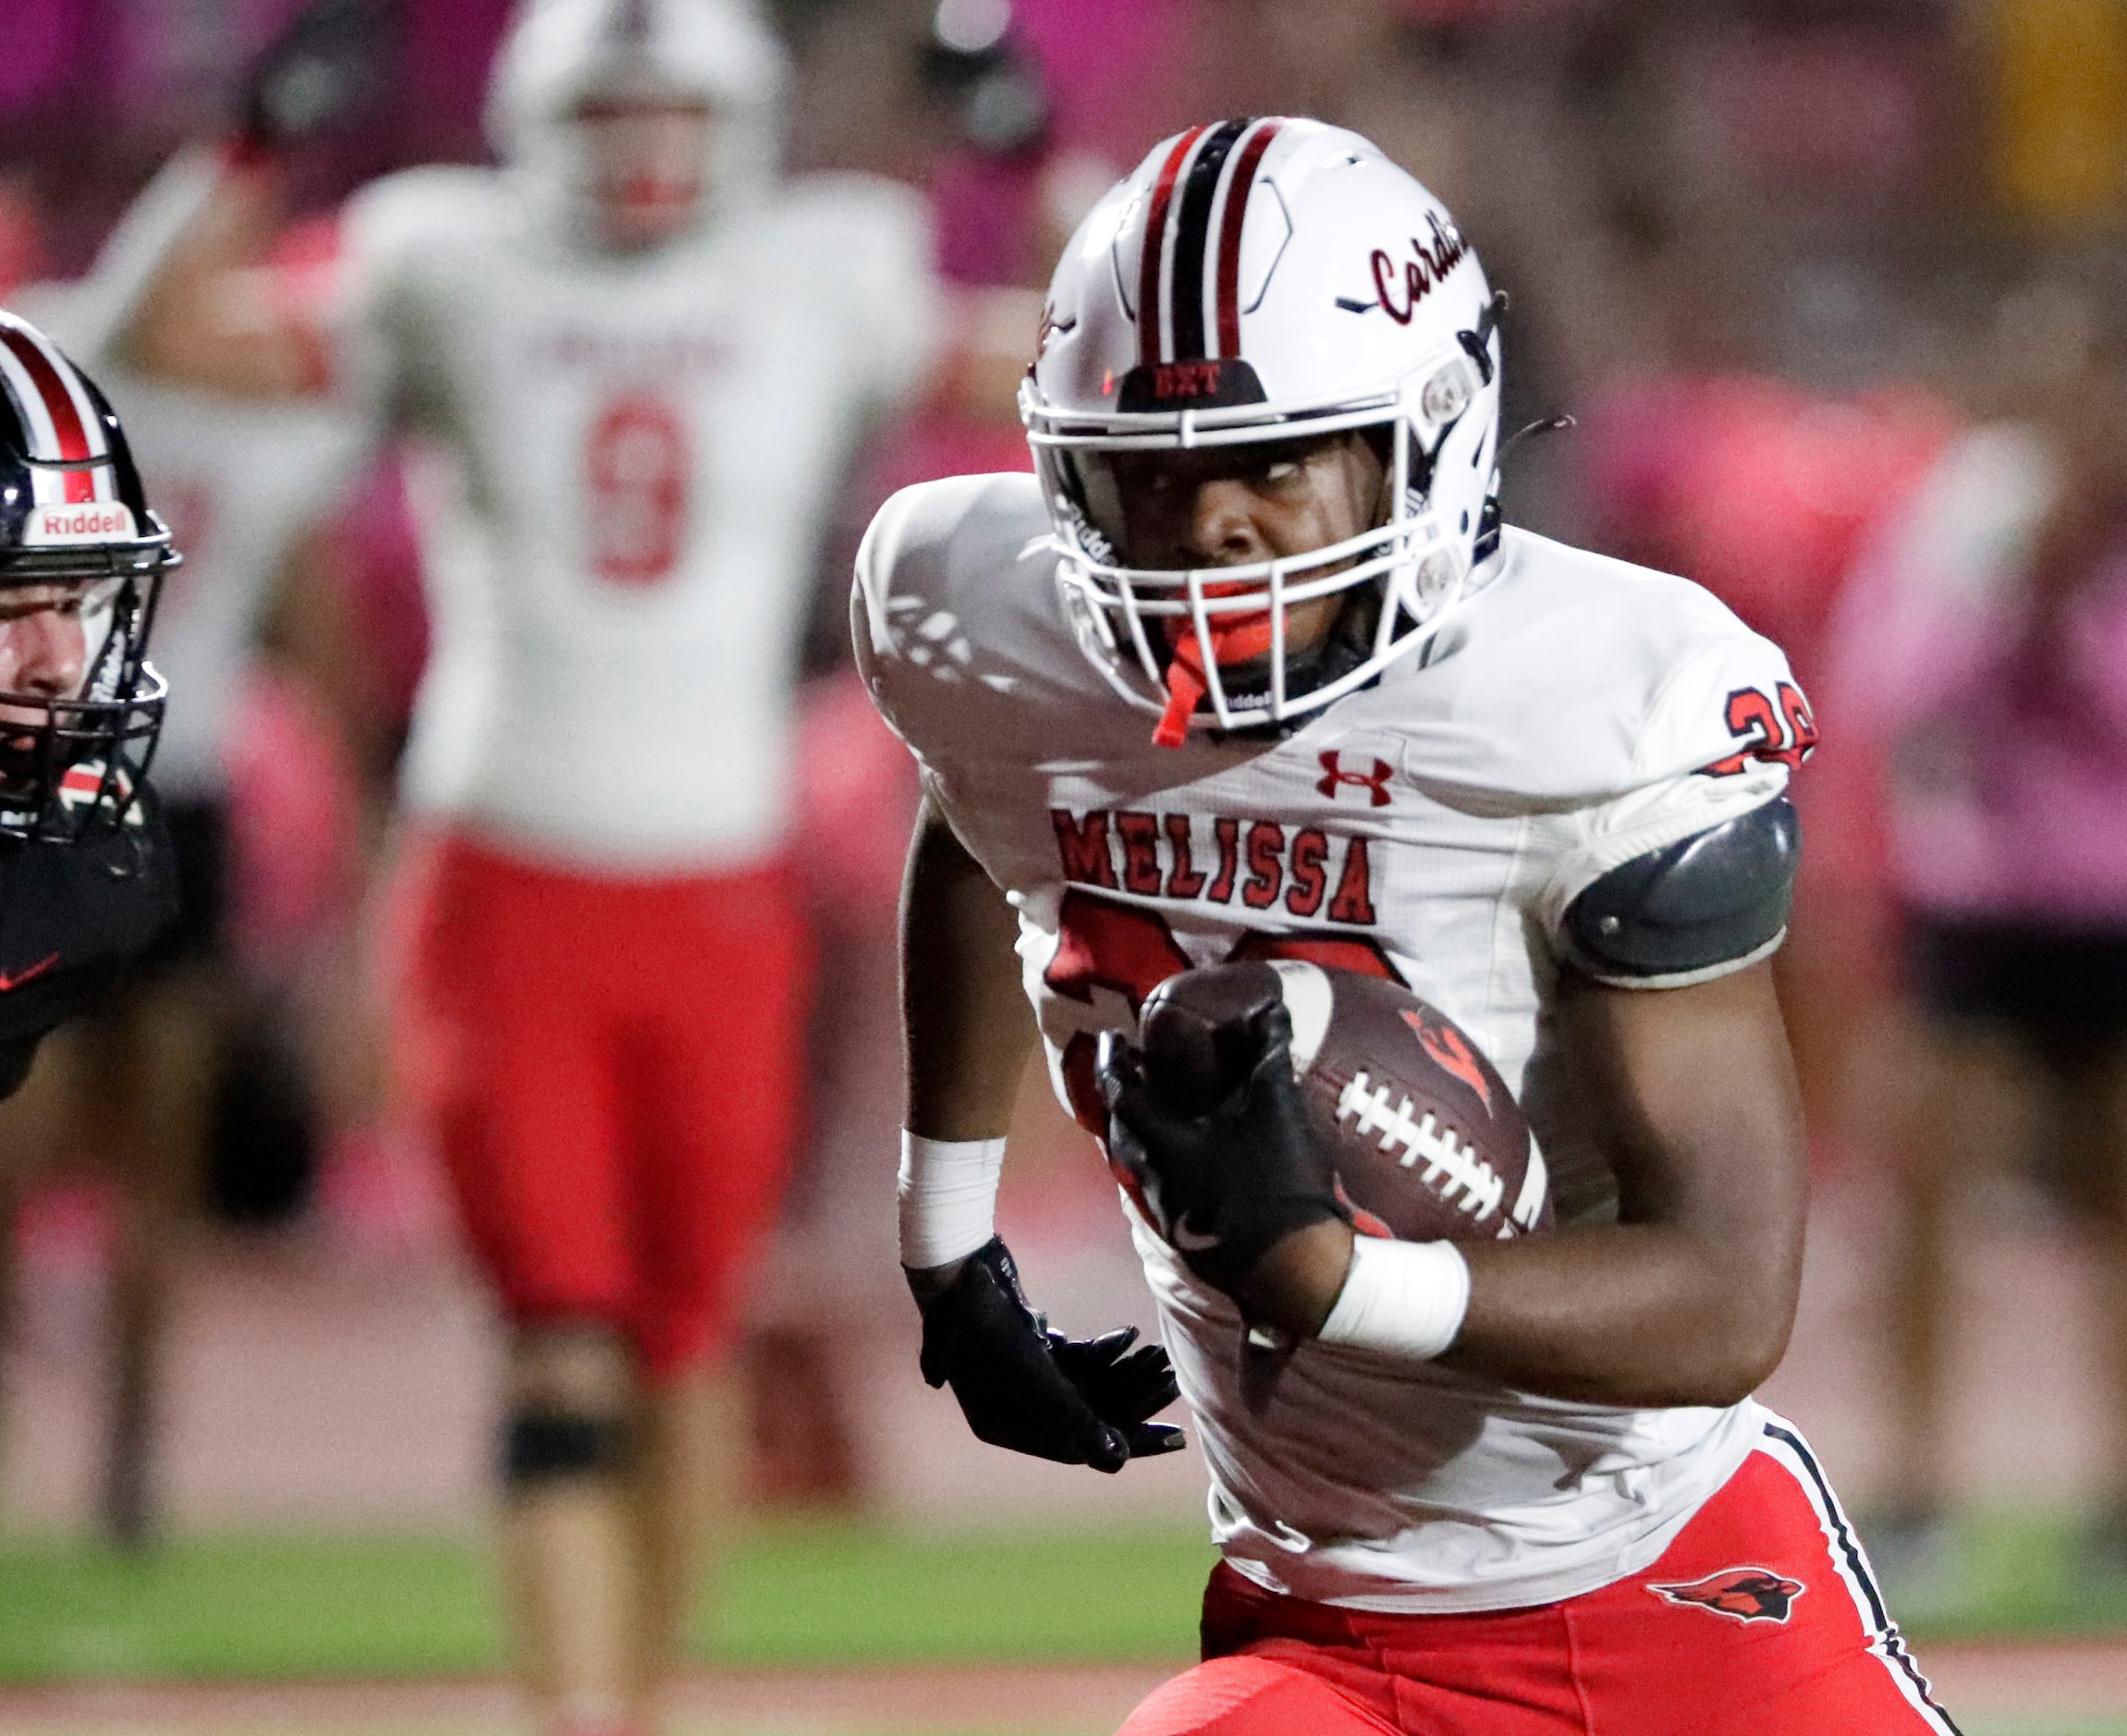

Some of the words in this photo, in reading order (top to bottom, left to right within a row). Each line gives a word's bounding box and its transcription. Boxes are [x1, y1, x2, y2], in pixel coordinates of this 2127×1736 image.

[44, 511, 127, 534] Riddell
[584, 396, 690, 584] 9
[1051, 808, 1377, 924] MELISSA
